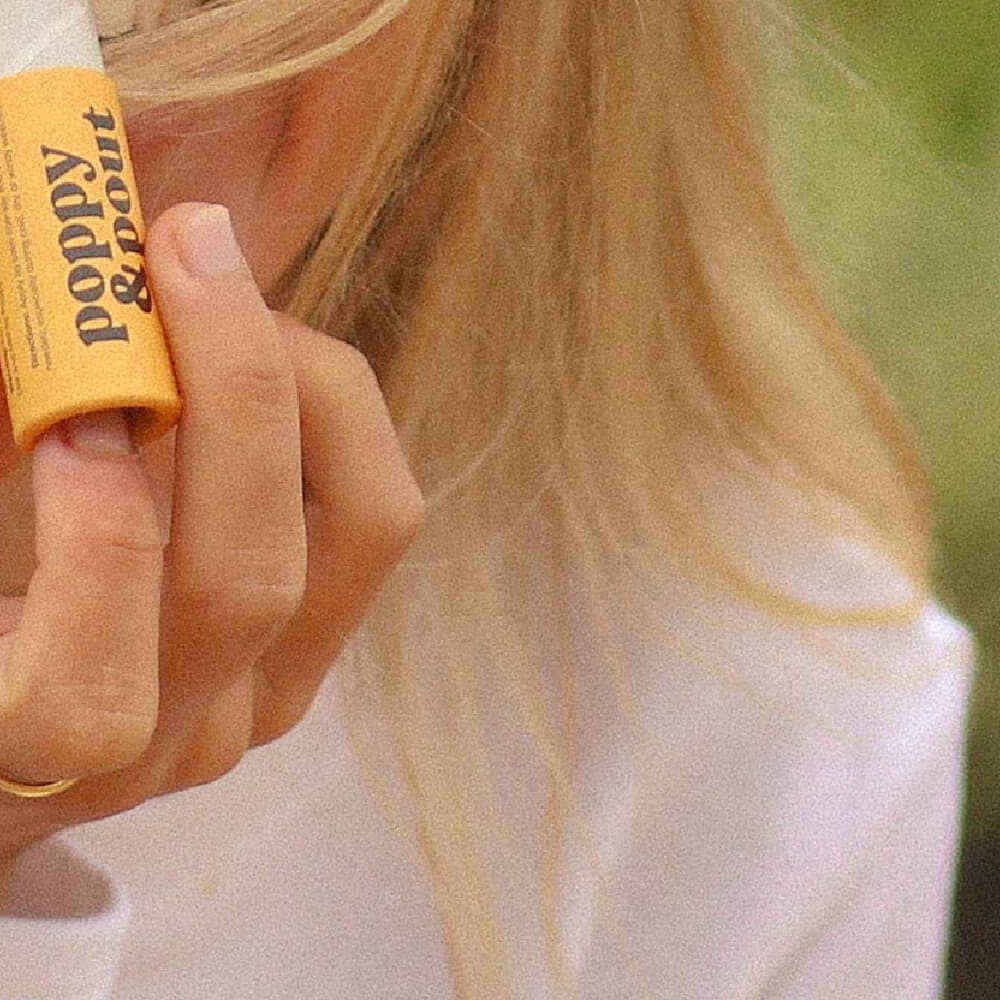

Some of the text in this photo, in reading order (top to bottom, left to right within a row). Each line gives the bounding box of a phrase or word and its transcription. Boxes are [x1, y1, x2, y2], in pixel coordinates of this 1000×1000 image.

[40, 144, 130, 347] poppy
[82, 105, 153, 313] & pout
